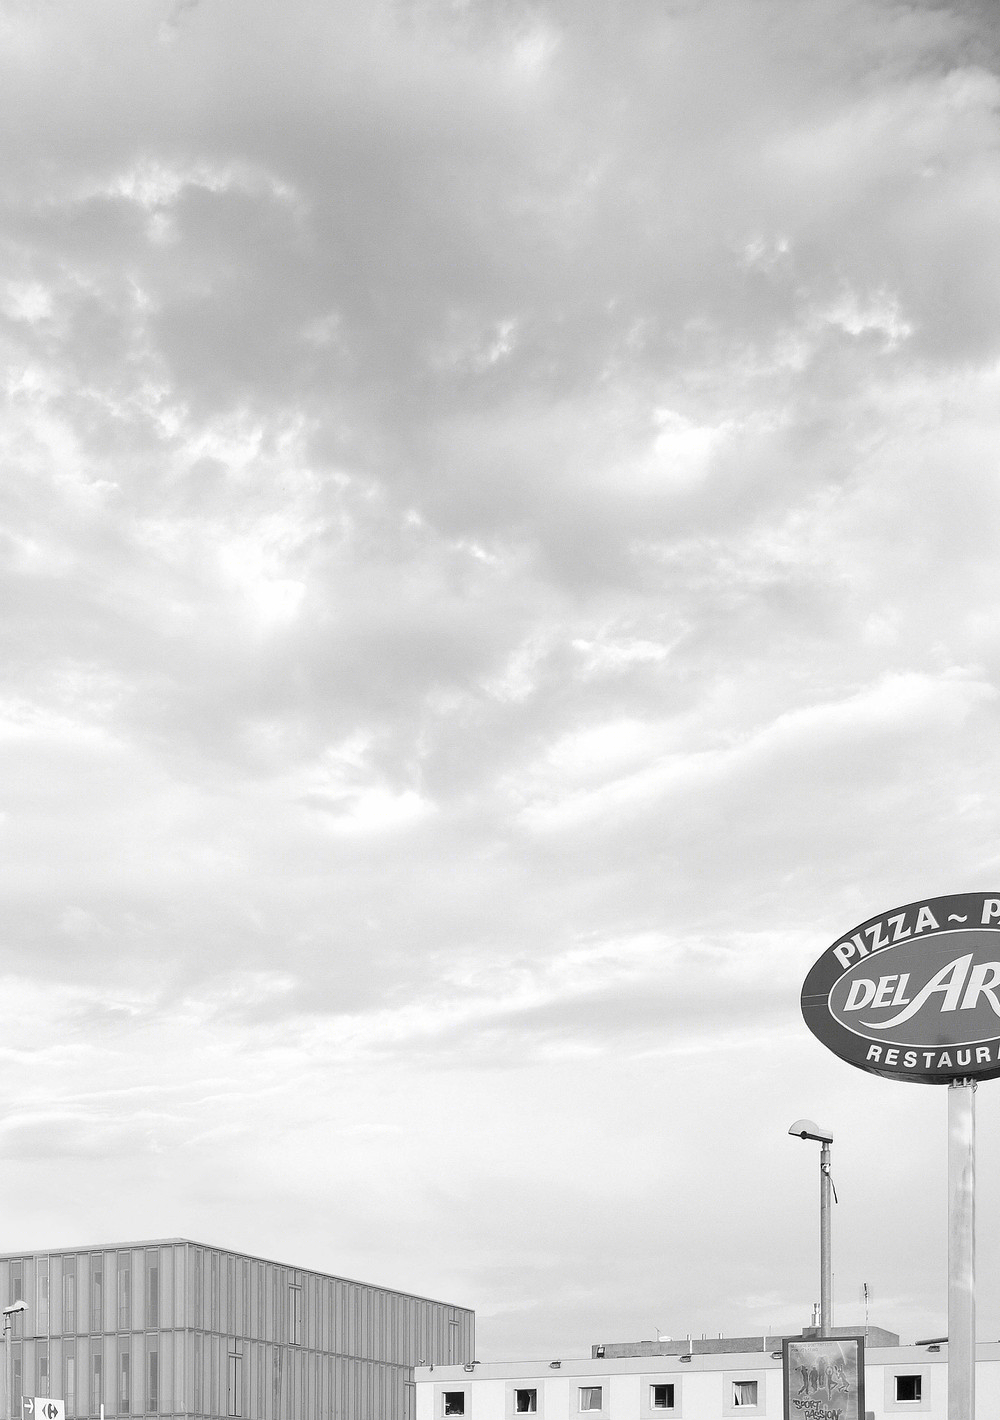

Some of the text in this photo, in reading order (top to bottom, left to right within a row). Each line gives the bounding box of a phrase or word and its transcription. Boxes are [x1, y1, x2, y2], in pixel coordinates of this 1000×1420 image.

[832, 898, 1000, 970] PIZZA P
[843, 973, 911, 1012] DEL
[865, 1044, 1000, 1069] RESTAUR
